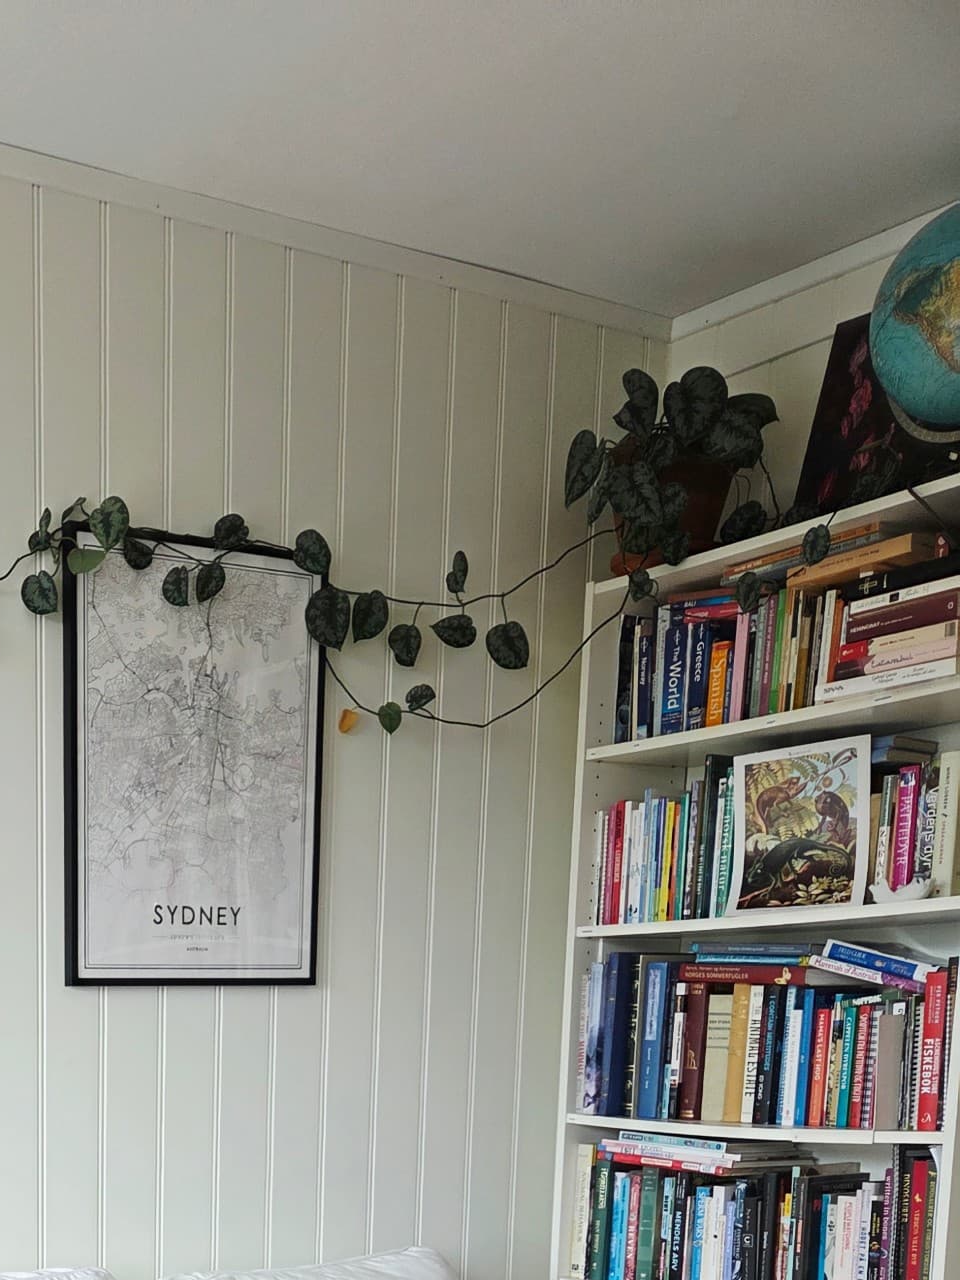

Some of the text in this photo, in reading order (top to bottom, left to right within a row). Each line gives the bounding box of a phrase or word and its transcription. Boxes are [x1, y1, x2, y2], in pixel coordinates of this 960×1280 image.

[639, 657, 648, 685] Norway
[667, 646, 682, 710] The World
[693, 641, 705, 682] Greece
[709, 659, 725, 721] Spanish
[897, 796, 912, 867] PATTEDYR
[919, 786, 940, 869] Verdens dyr
[153, 904, 241, 927] SYDNEY
[814, 1064, 822, 1081] HUG
[816, 1044, 824, 1062] LAST
[921, 1038, 934, 1095] FISKEBOK
[881, 1175, 892, 1241] written in bones
[901, 1173, 911, 1224] DINOSAURER
[671, 1211, 682, 1271] MENDELS ARV
